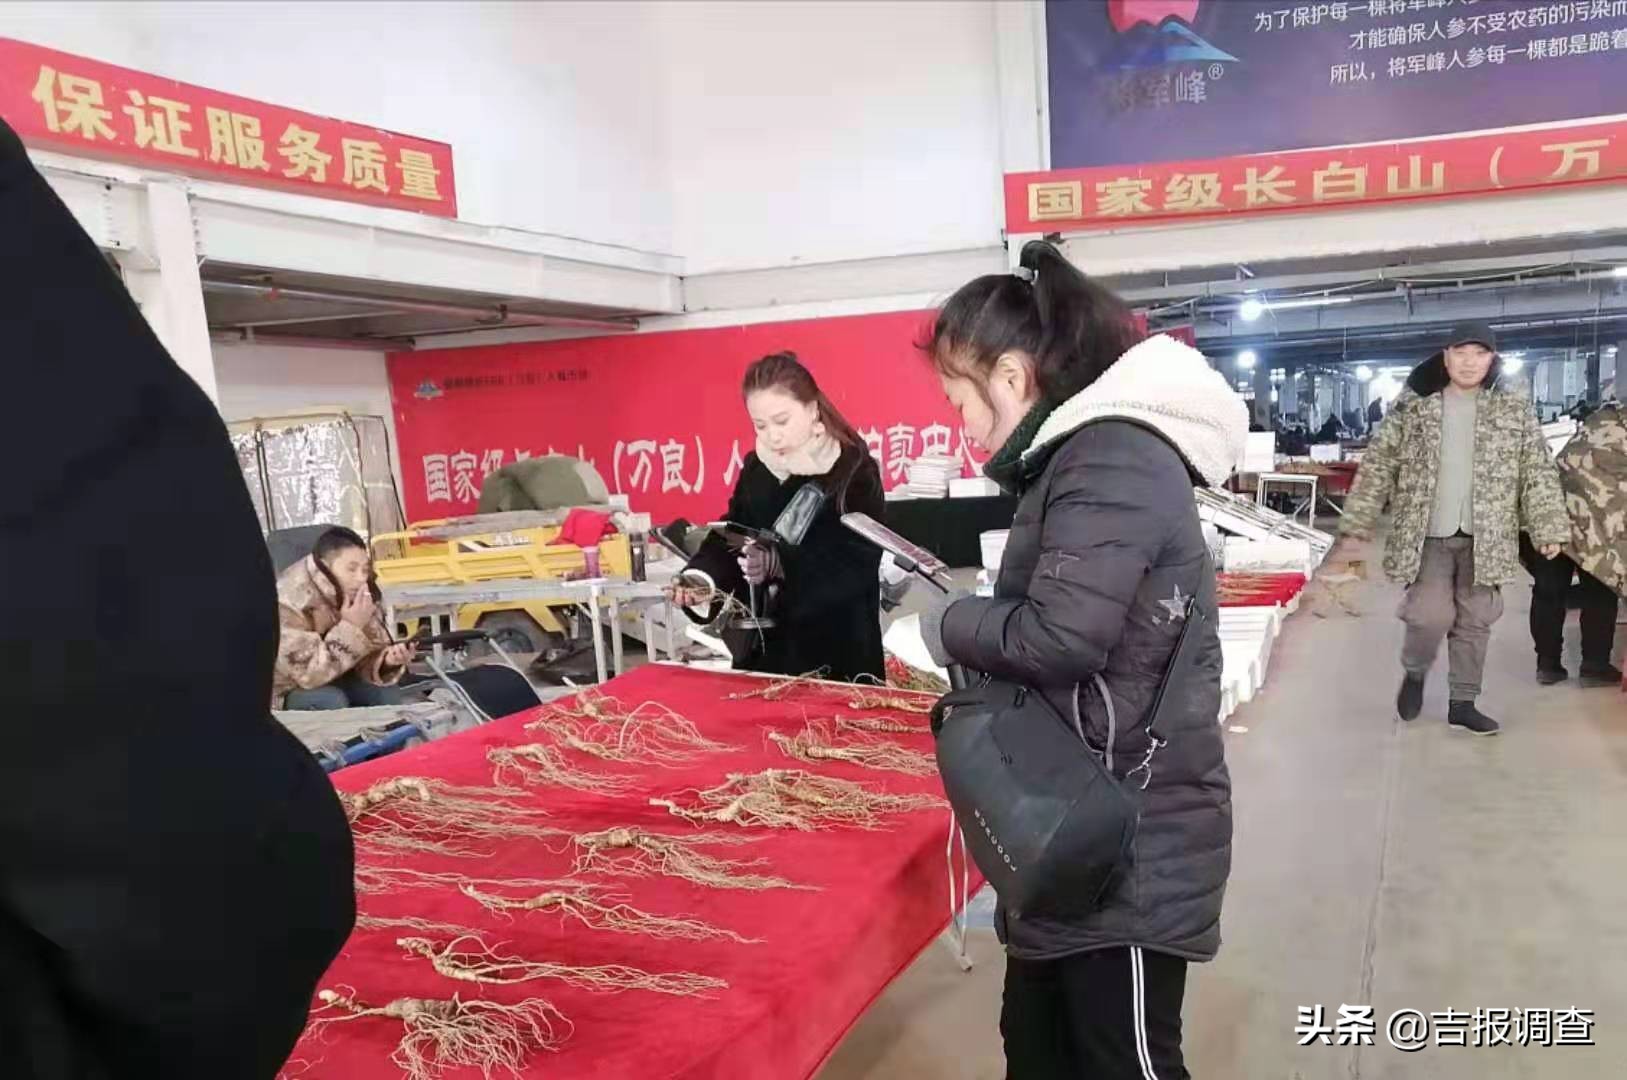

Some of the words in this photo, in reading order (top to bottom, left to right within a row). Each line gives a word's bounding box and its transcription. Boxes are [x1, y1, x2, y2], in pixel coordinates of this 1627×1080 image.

[31, 65, 443, 202] 保证服务质量
[1027, 138, 1610, 222] 国家级长白山（万
